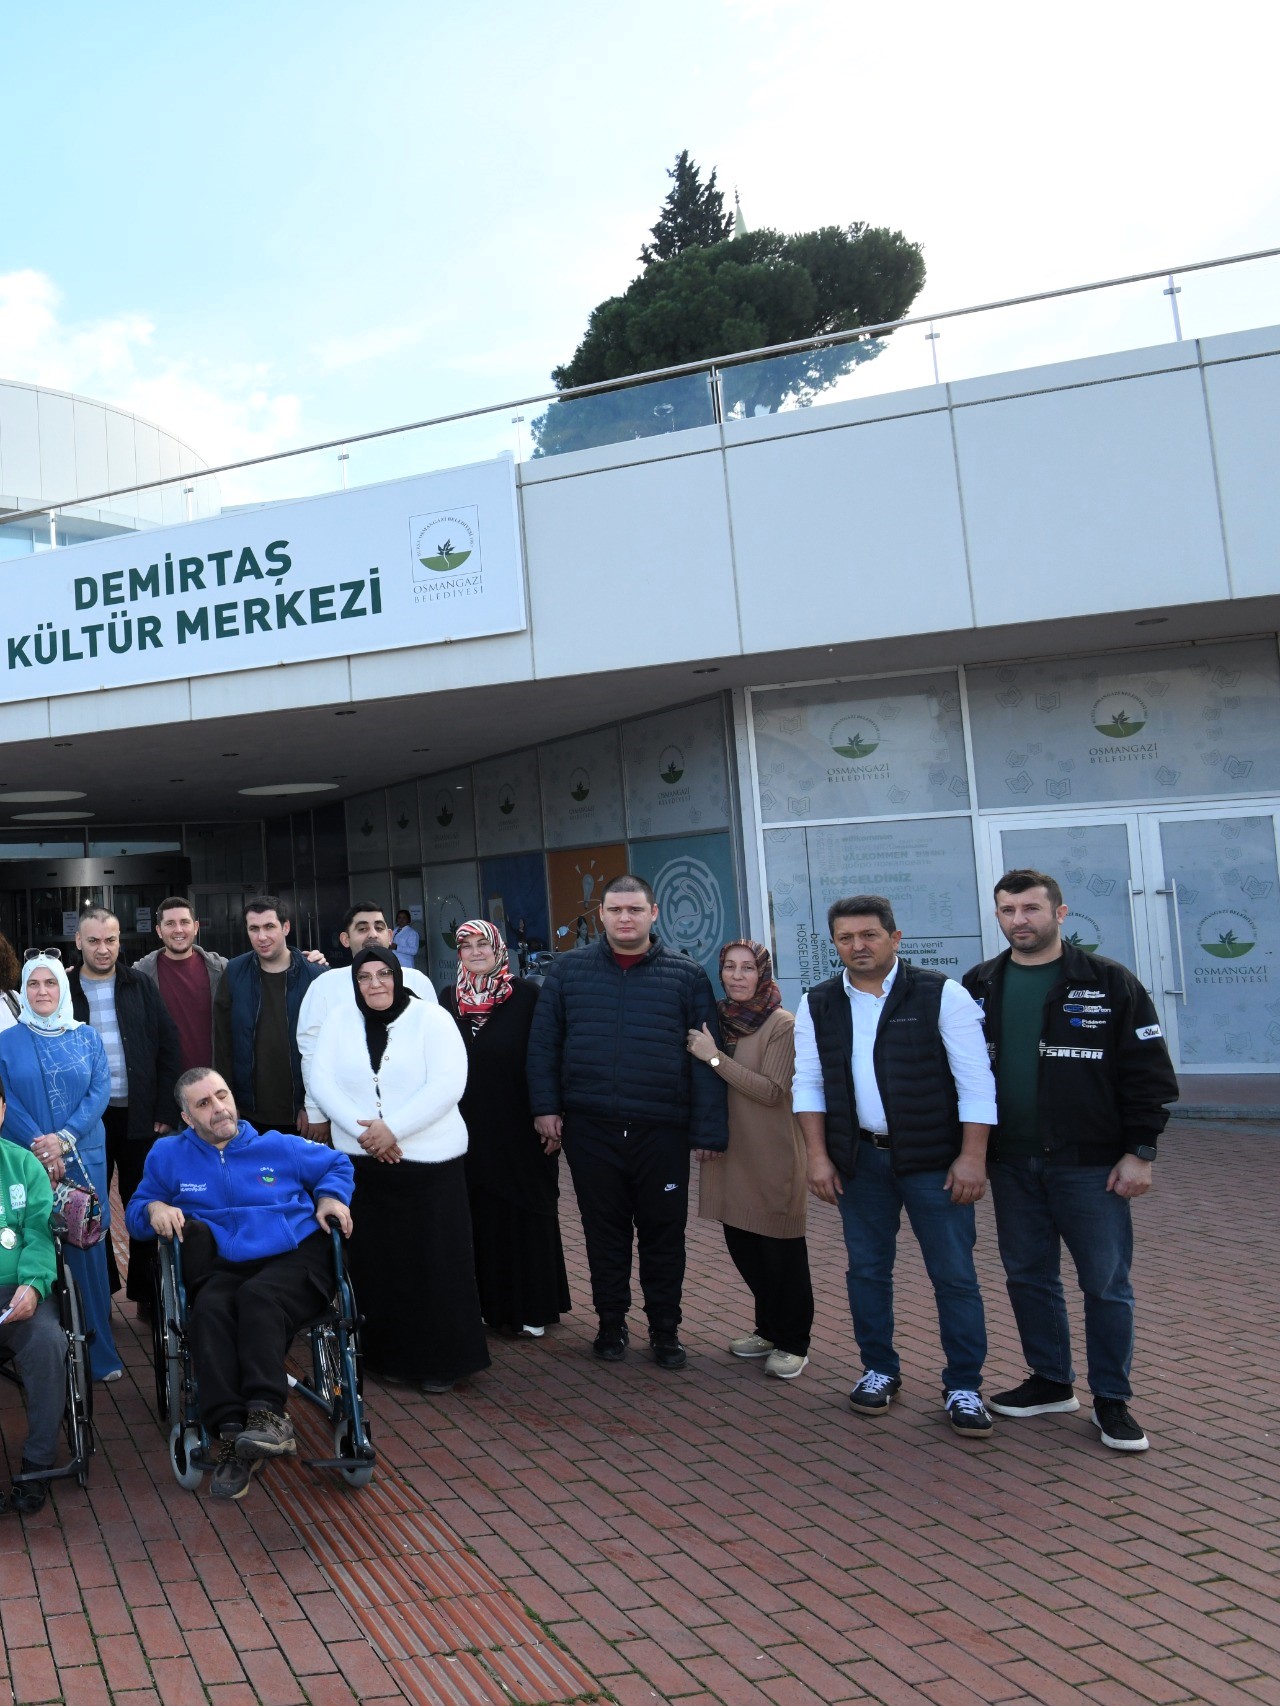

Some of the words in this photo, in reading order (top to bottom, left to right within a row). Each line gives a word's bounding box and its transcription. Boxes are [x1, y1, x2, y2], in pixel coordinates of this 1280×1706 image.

[74, 539, 293, 612] DEMİRTAŞ
[7, 614, 163, 671] KÜLTÜR
[177, 567, 384, 646] MERKEZİ
[796, 923, 812, 986] HOŞGELDİNİZ
[810, 933, 821, 981] benvenuto
[900, 941, 919, 949] bun
[921, 941, 943, 949] venit
